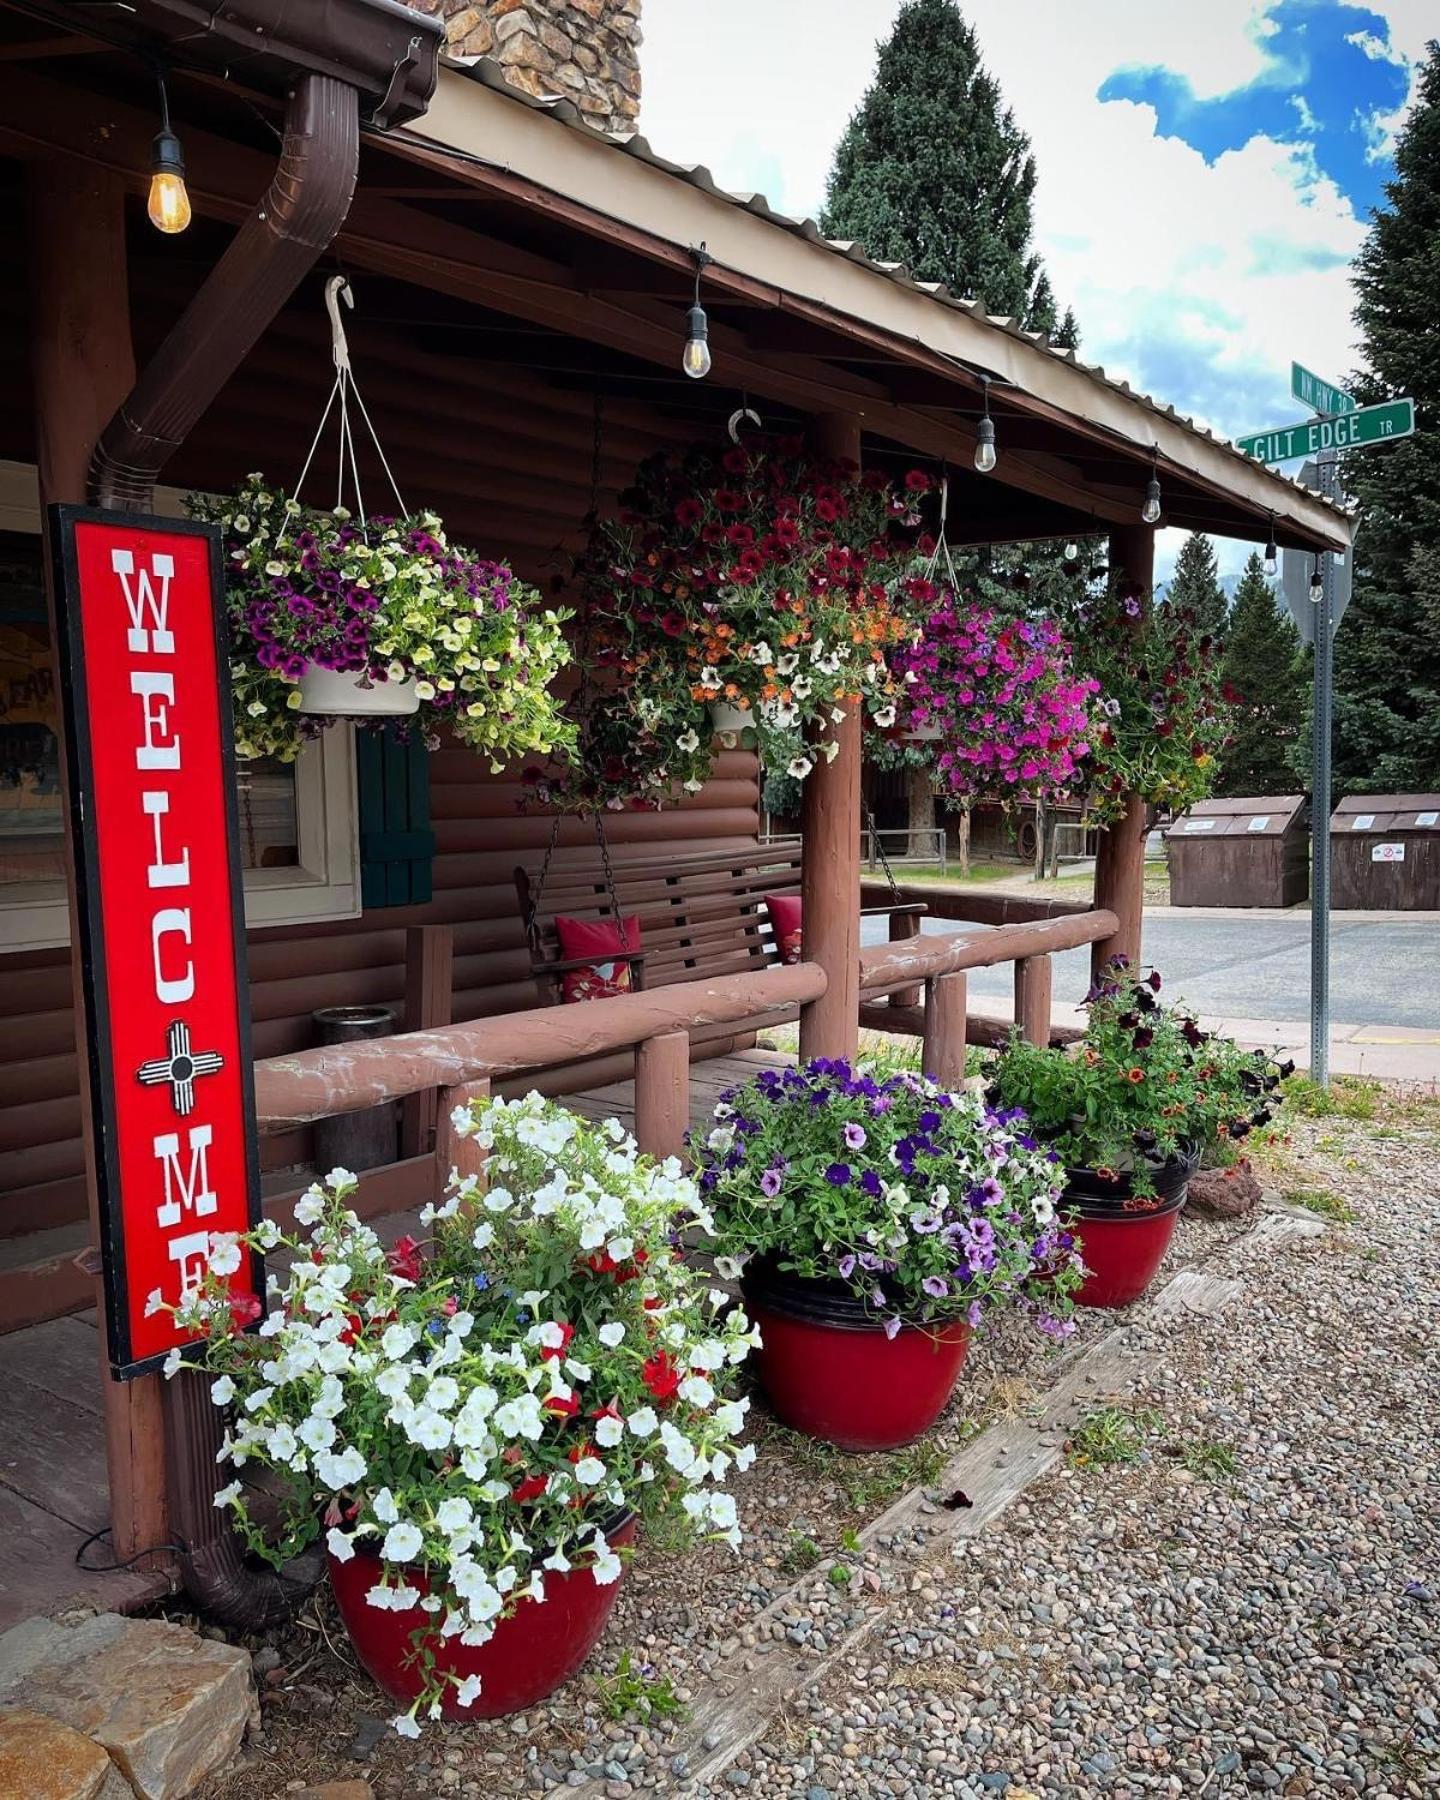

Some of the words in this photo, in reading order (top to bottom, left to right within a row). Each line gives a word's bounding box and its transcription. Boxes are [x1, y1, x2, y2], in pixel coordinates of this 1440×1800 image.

[1301, 370, 1313, 402] NM
[1316, 382, 1334, 413] HWY
[1253, 430, 1295, 462] GILT
[1308, 415, 1361, 452] EDGE
[1379, 420, 1393, 435] TR
